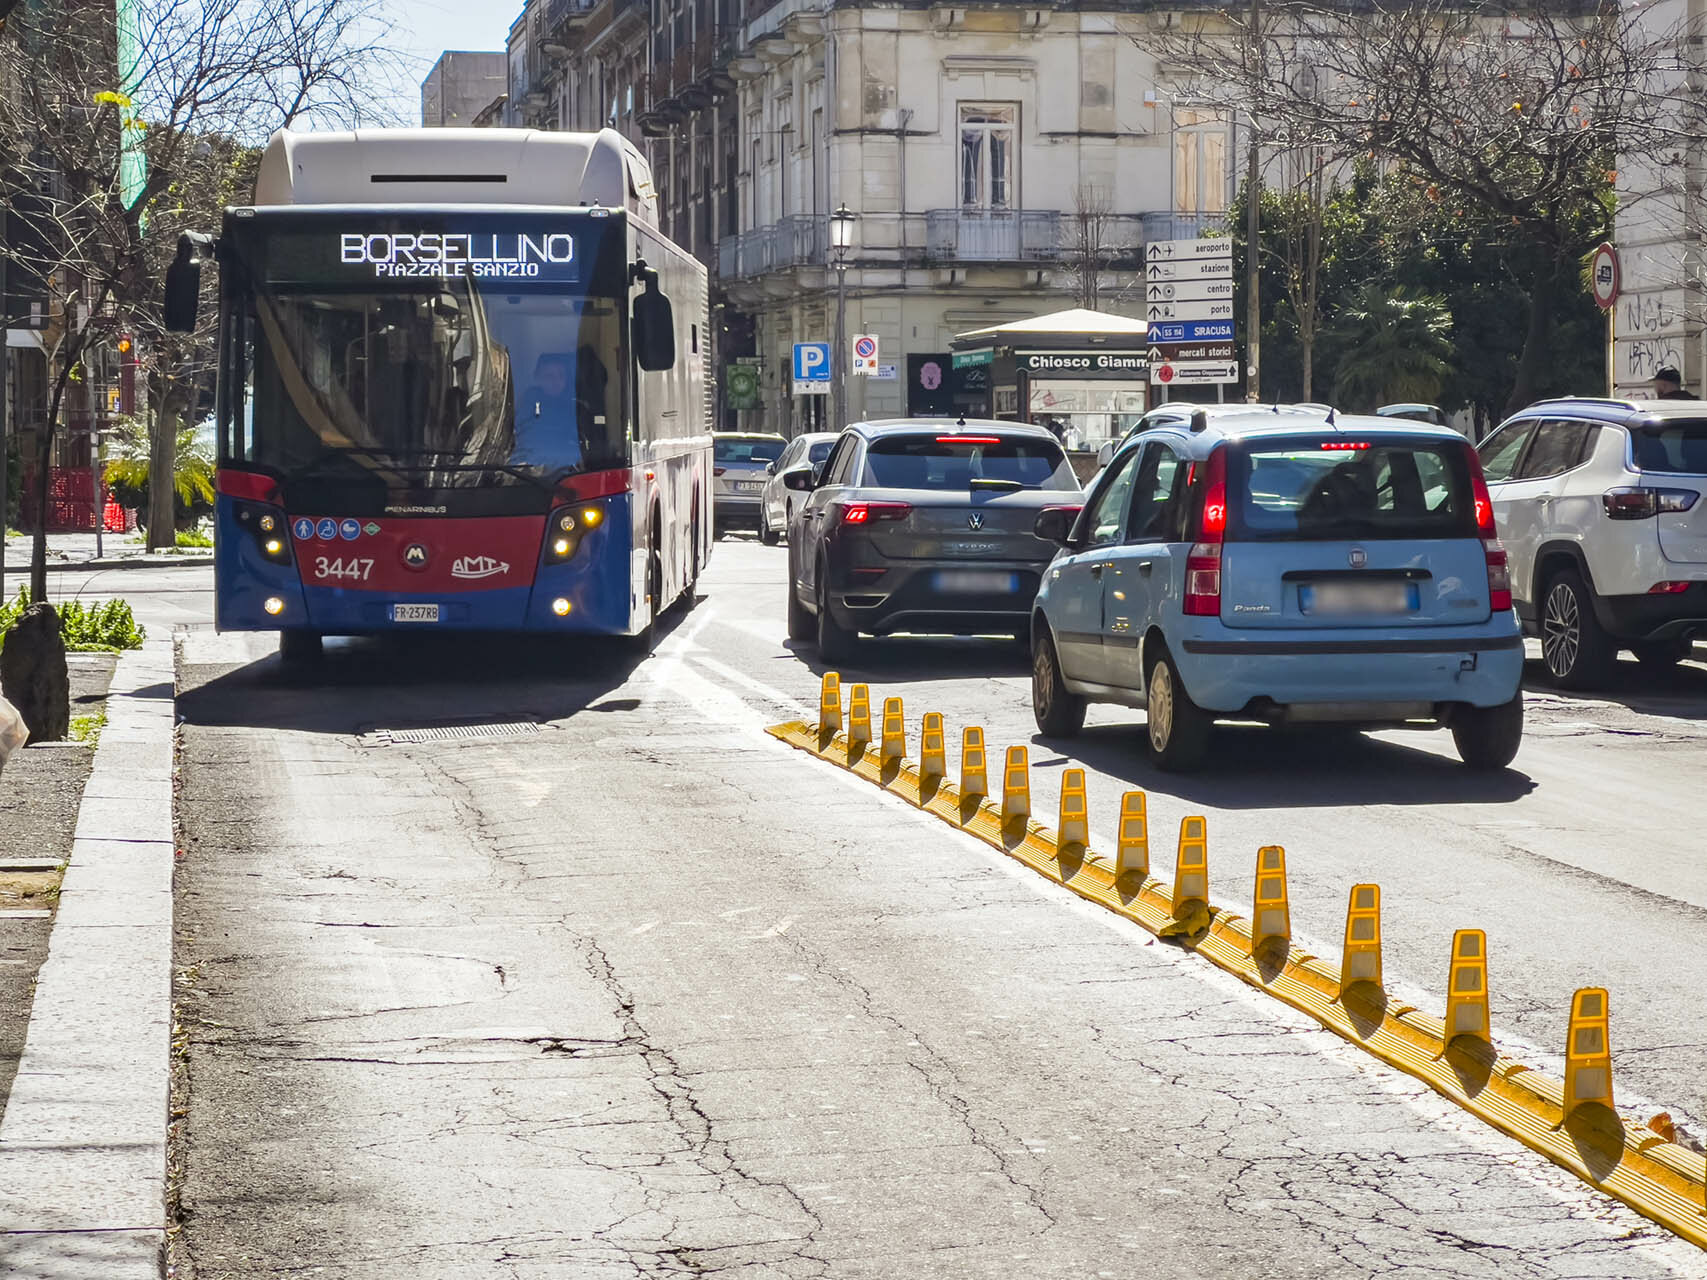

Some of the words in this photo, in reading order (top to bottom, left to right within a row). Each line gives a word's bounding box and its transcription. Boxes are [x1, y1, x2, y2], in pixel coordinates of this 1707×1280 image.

[340, 233, 574, 263] BORSELLINO
[1196, 244, 1229, 253] aeroporto
[375, 263, 466, 277] PIAZZALE
[472, 263, 539, 277] SANZIO
[1200, 263, 1229, 273] stazione
[1207, 285, 1230, 293] centro
[1210, 305, 1230, 315] porto
[1194, 325, 1231, 336] SIRACUSA
[1179, 347, 1206, 357] mercati
[1208, 346, 1231, 356] storici
[801, 346, 824, 377] P
[1029, 356, 1090, 368] Chiosco
[315, 557, 374, 580] 3447
[452, 556, 496, 574] AMT
[1234, 604, 1271, 612] Panda
